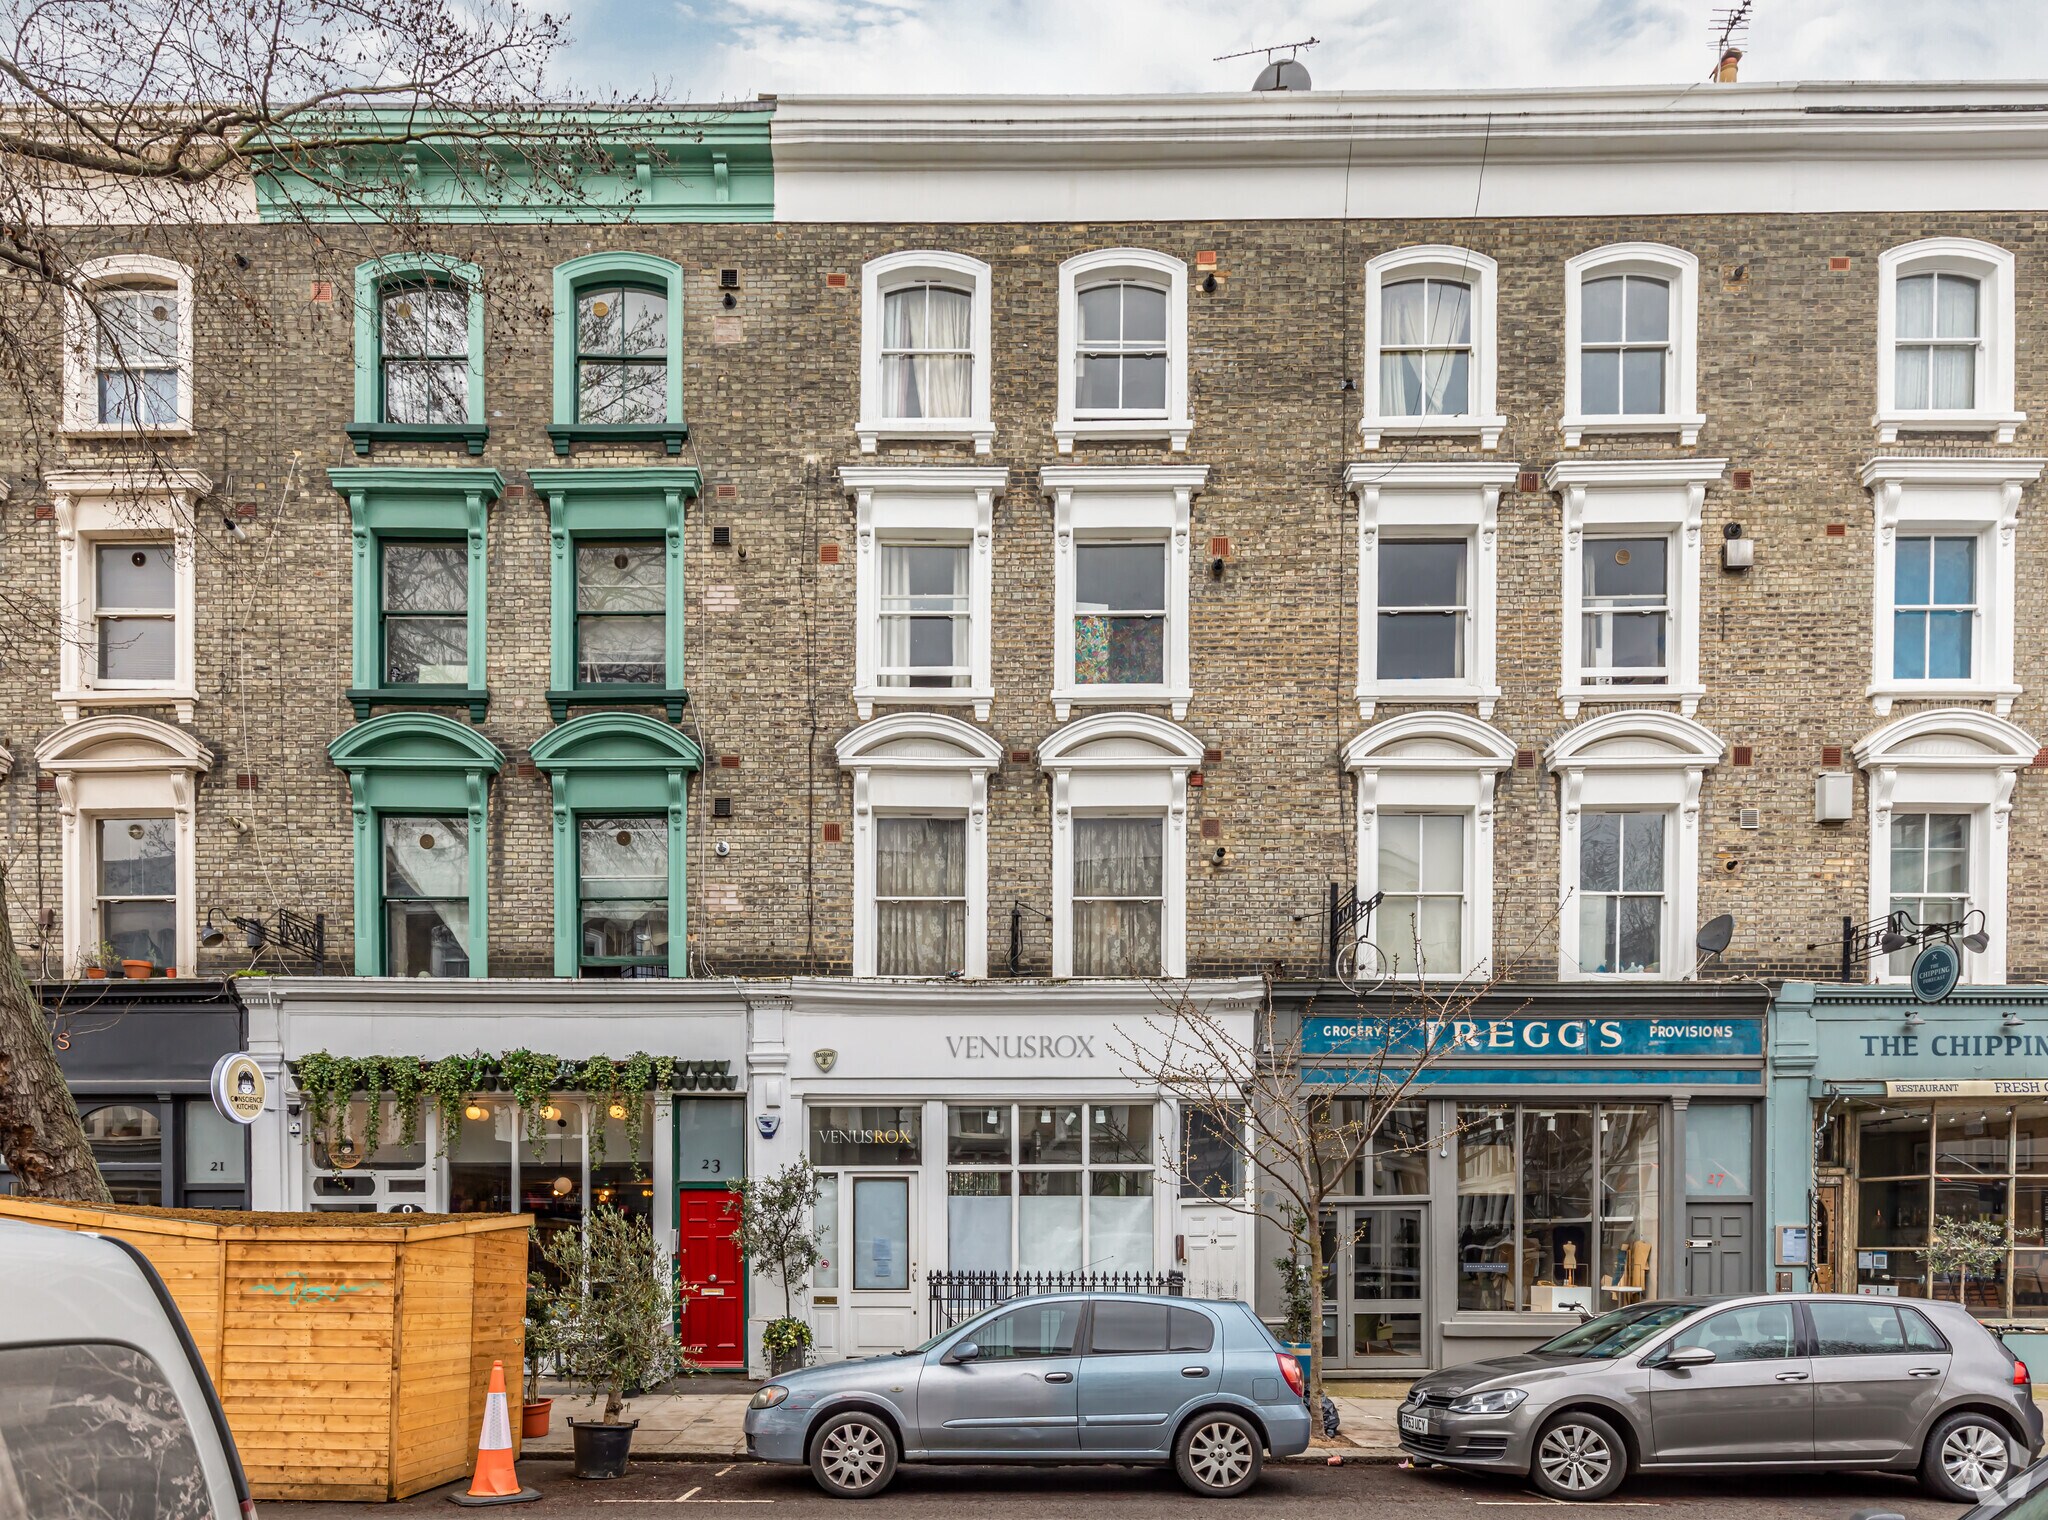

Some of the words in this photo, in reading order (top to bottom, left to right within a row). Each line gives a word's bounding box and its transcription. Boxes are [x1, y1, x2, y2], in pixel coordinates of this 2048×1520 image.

[1919, 966, 1950, 979] CHIPPING
[1323, 1025, 1382, 1037] GROCERY
[1420, 1019, 1622, 1048] TREGG'S
[1650, 1025, 1733, 1038] PROVISIONS
[945, 1034, 1095, 1059] VENUSROX
[1859, 1035, 1919, 1057] THE
[1895, 1083, 1959, 1093] RESTAURANT
[1994, 1081, 2041, 1093] FRESH
[230, 1095, 264, 1104] CONSCIENCE
[819, 1129, 912, 1144] VENUSROX
[210, 1161, 224, 1171] 21
[701, 1159, 720, 1173] 23
[1707, 1173, 1725, 1189] 27
[1415, 1418, 1426, 1431] UCY
